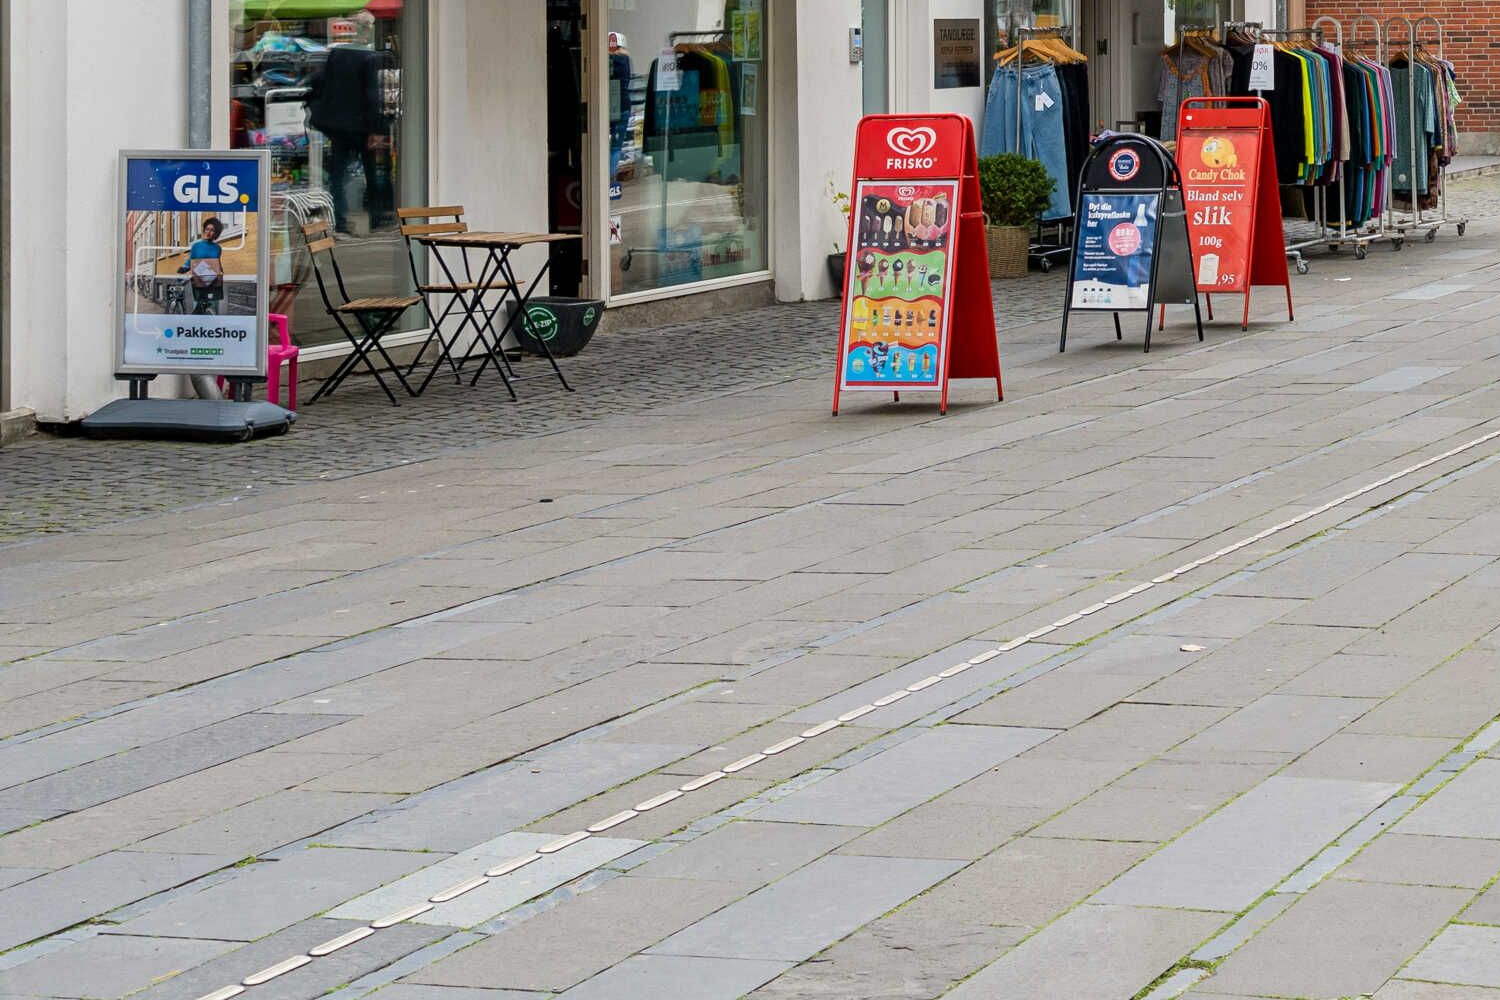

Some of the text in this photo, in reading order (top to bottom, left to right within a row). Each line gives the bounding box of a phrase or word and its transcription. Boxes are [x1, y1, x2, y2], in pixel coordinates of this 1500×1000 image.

[1188, 168, 1245, 183] Candy Chok
[1187, 190, 1244, 201] Bland selv
[1193, 206, 1232, 225] slik
[1199, 236, 1222, 248] 100g
[176, 326, 247, 342] PakkeShop
